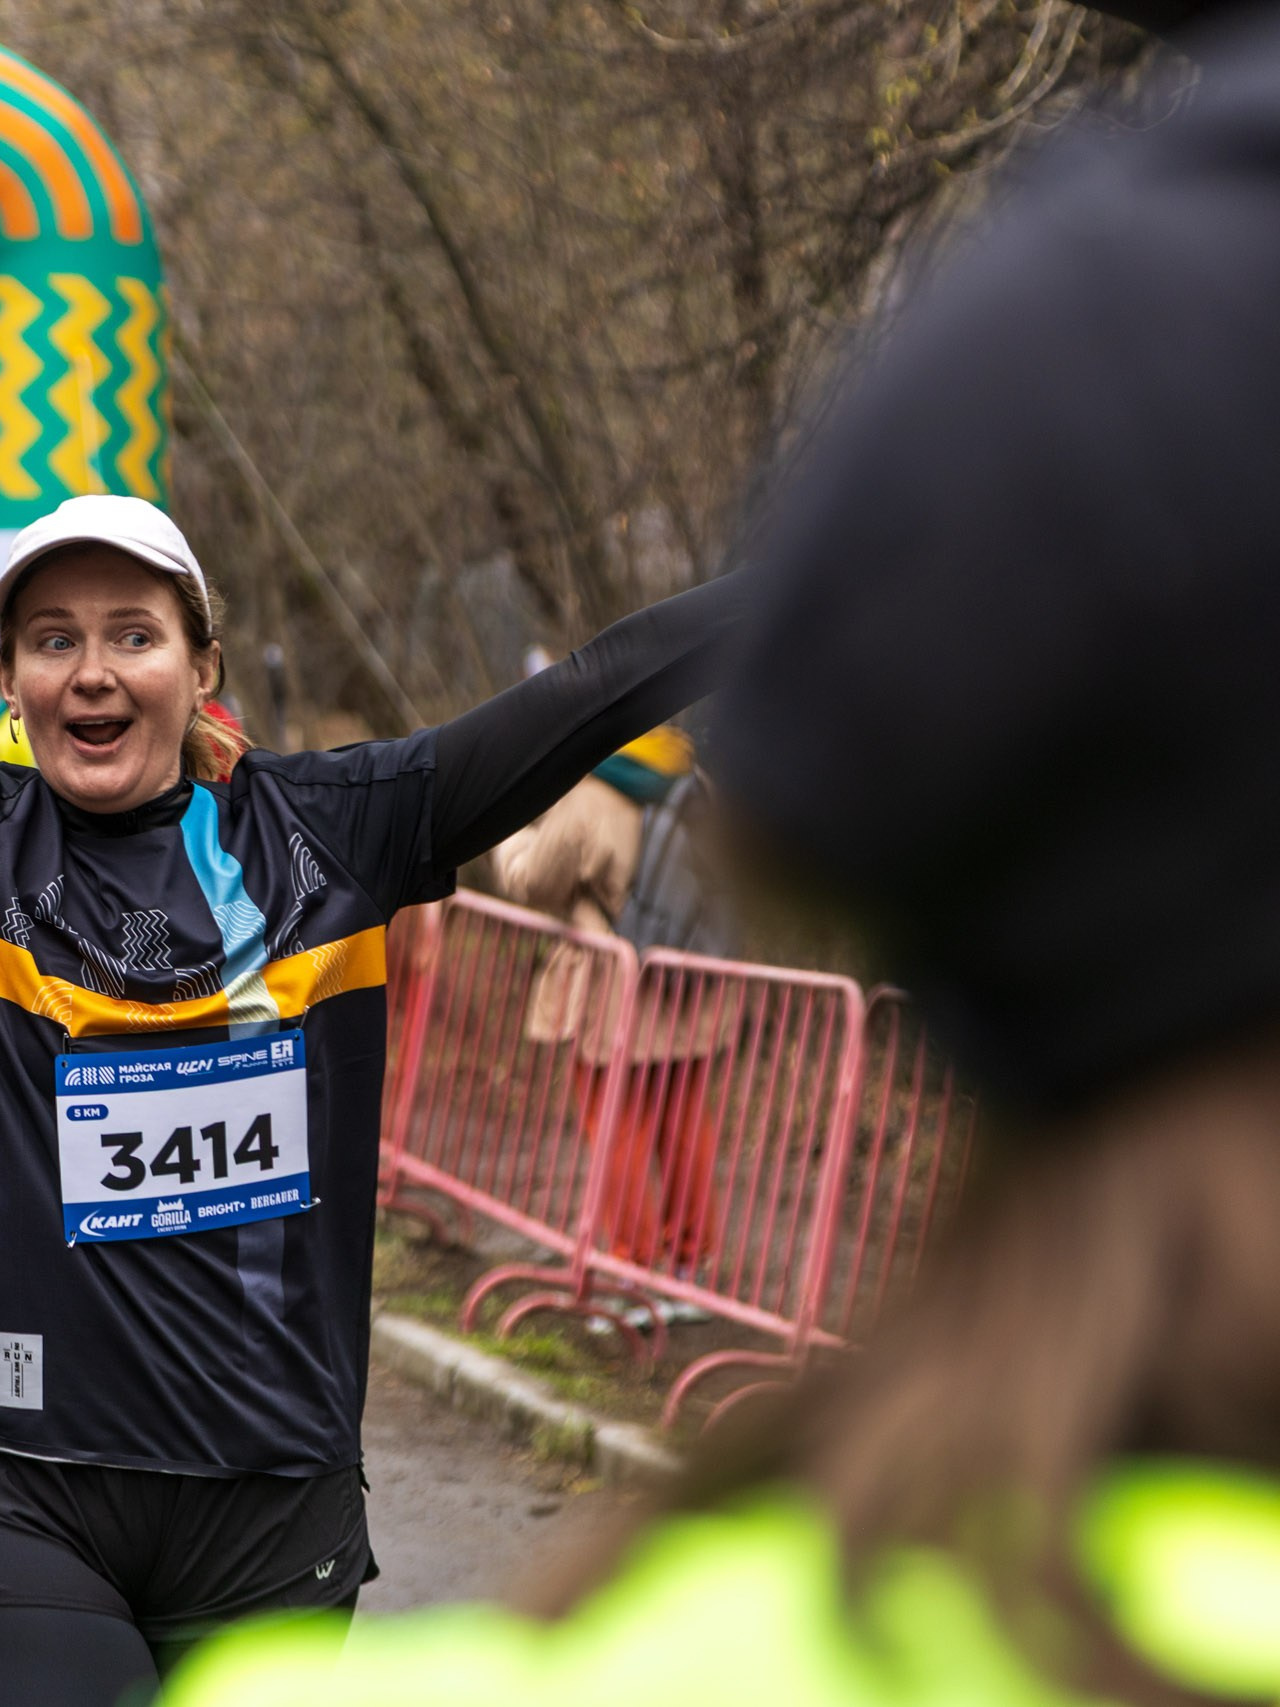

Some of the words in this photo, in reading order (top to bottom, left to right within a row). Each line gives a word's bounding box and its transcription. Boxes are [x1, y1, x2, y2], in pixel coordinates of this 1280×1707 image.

[217, 1049, 268, 1067] SPINE
[118, 1062, 172, 1075] МАЙСКАЯ
[119, 1073, 155, 1084] ГРОЗА
[73, 1108, 81, 1118] 5
[83, 1107, 101, 1118] KM
[100, 1113, 280, 1191] 3414
[250, 1188, 300, 1209] BERGAUER
[151, 1209, 192, 1228] GORILLA
[4, 1351, 32, 1361] RUN
